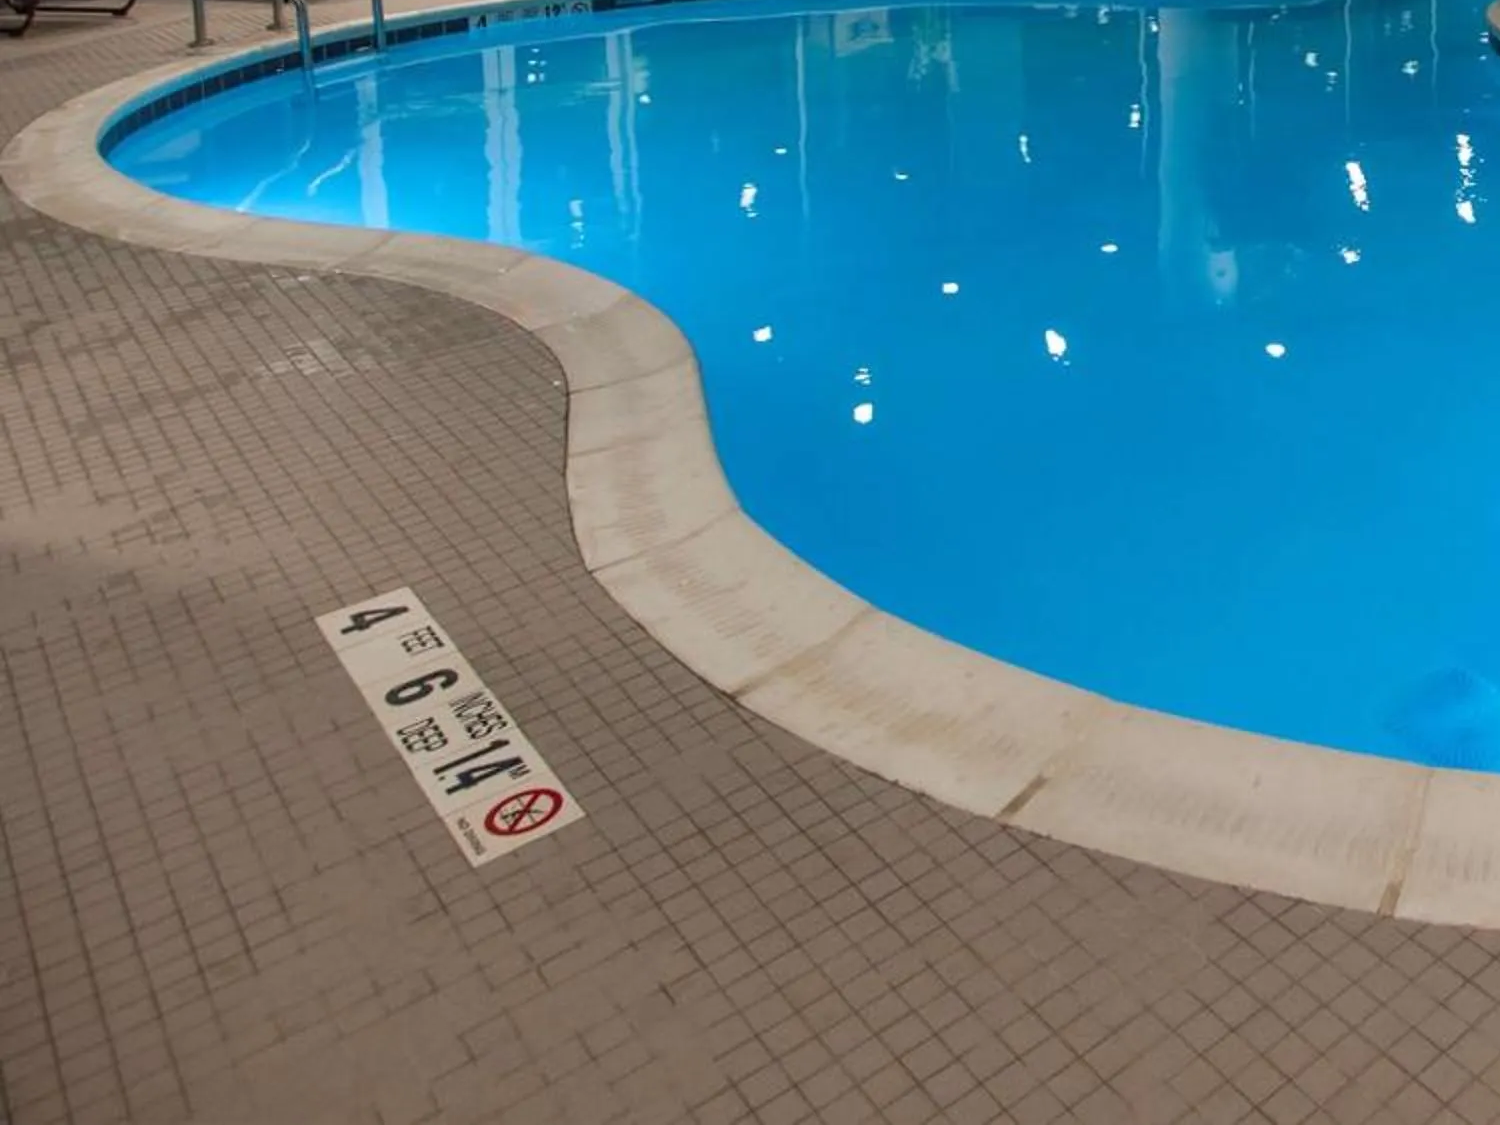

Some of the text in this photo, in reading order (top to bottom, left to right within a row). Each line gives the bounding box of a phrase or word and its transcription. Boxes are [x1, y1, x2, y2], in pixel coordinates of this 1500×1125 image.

[340, 606, 409, 635] 4
[398, 625, 445, 655] FEET
[385, 668, 459, 706] 6
[449, 691, 508, 740] INCHES
[397, 717, 448, 753] DEEP
